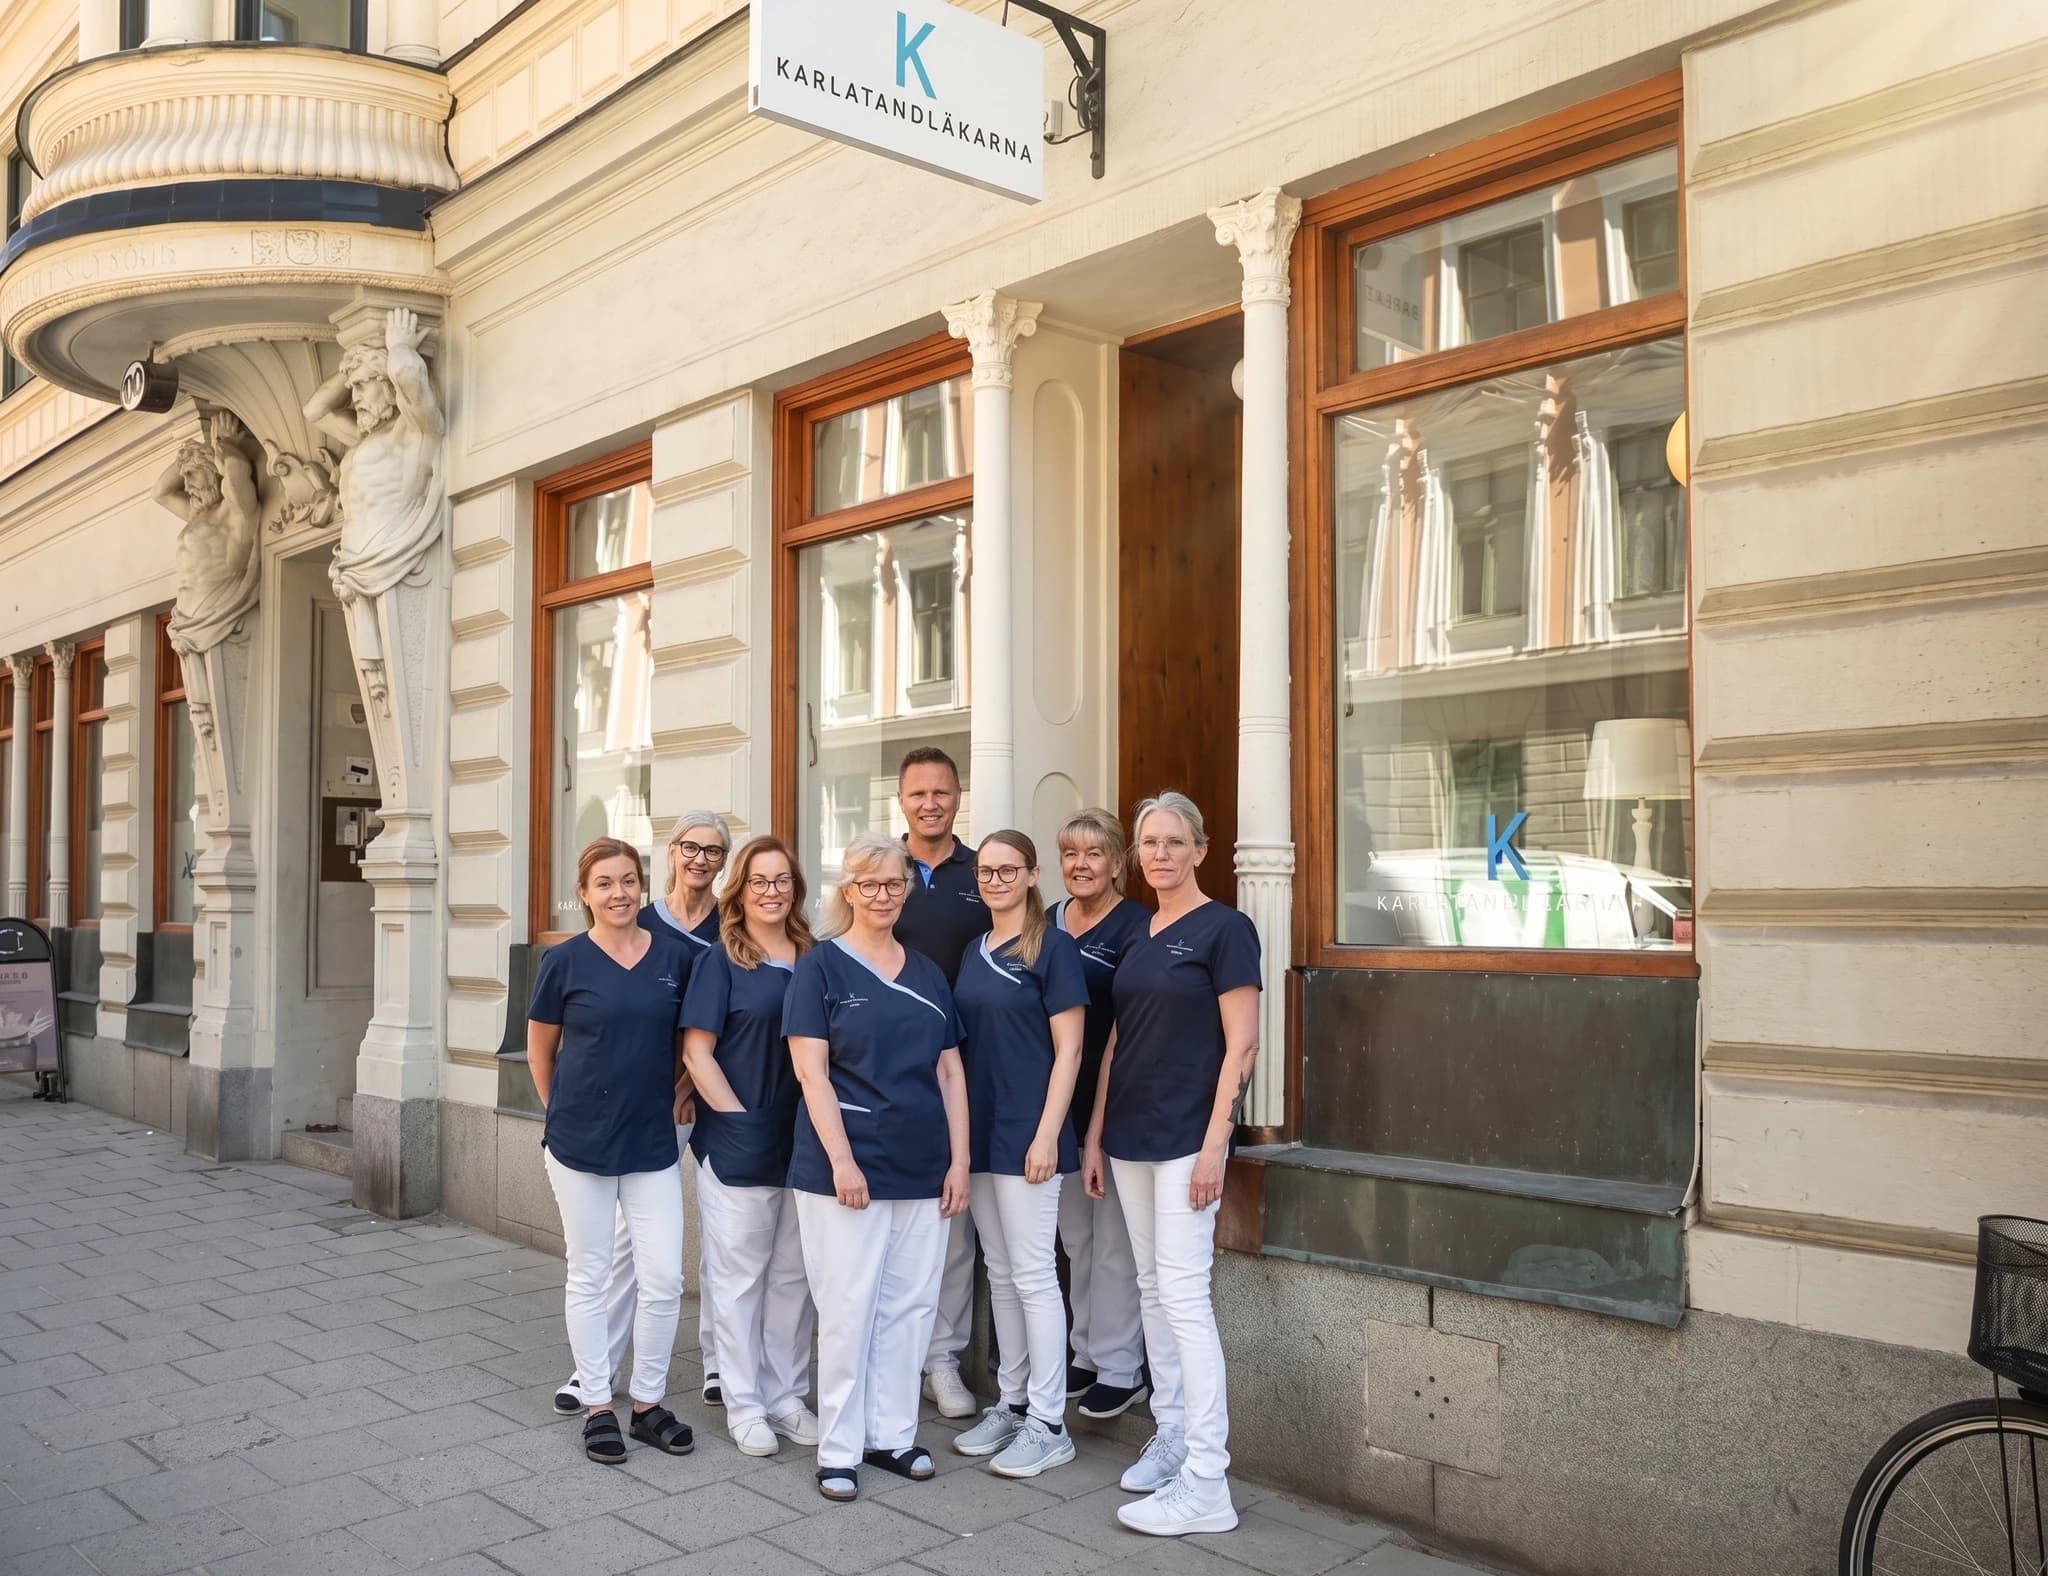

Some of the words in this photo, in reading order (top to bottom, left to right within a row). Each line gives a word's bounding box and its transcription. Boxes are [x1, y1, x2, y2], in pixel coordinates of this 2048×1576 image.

[895, 10, 937, 100] K
[776, 56, 1032, 164] KARLATANDLÄKARNA
[1487, 811, 1530, 880] K
